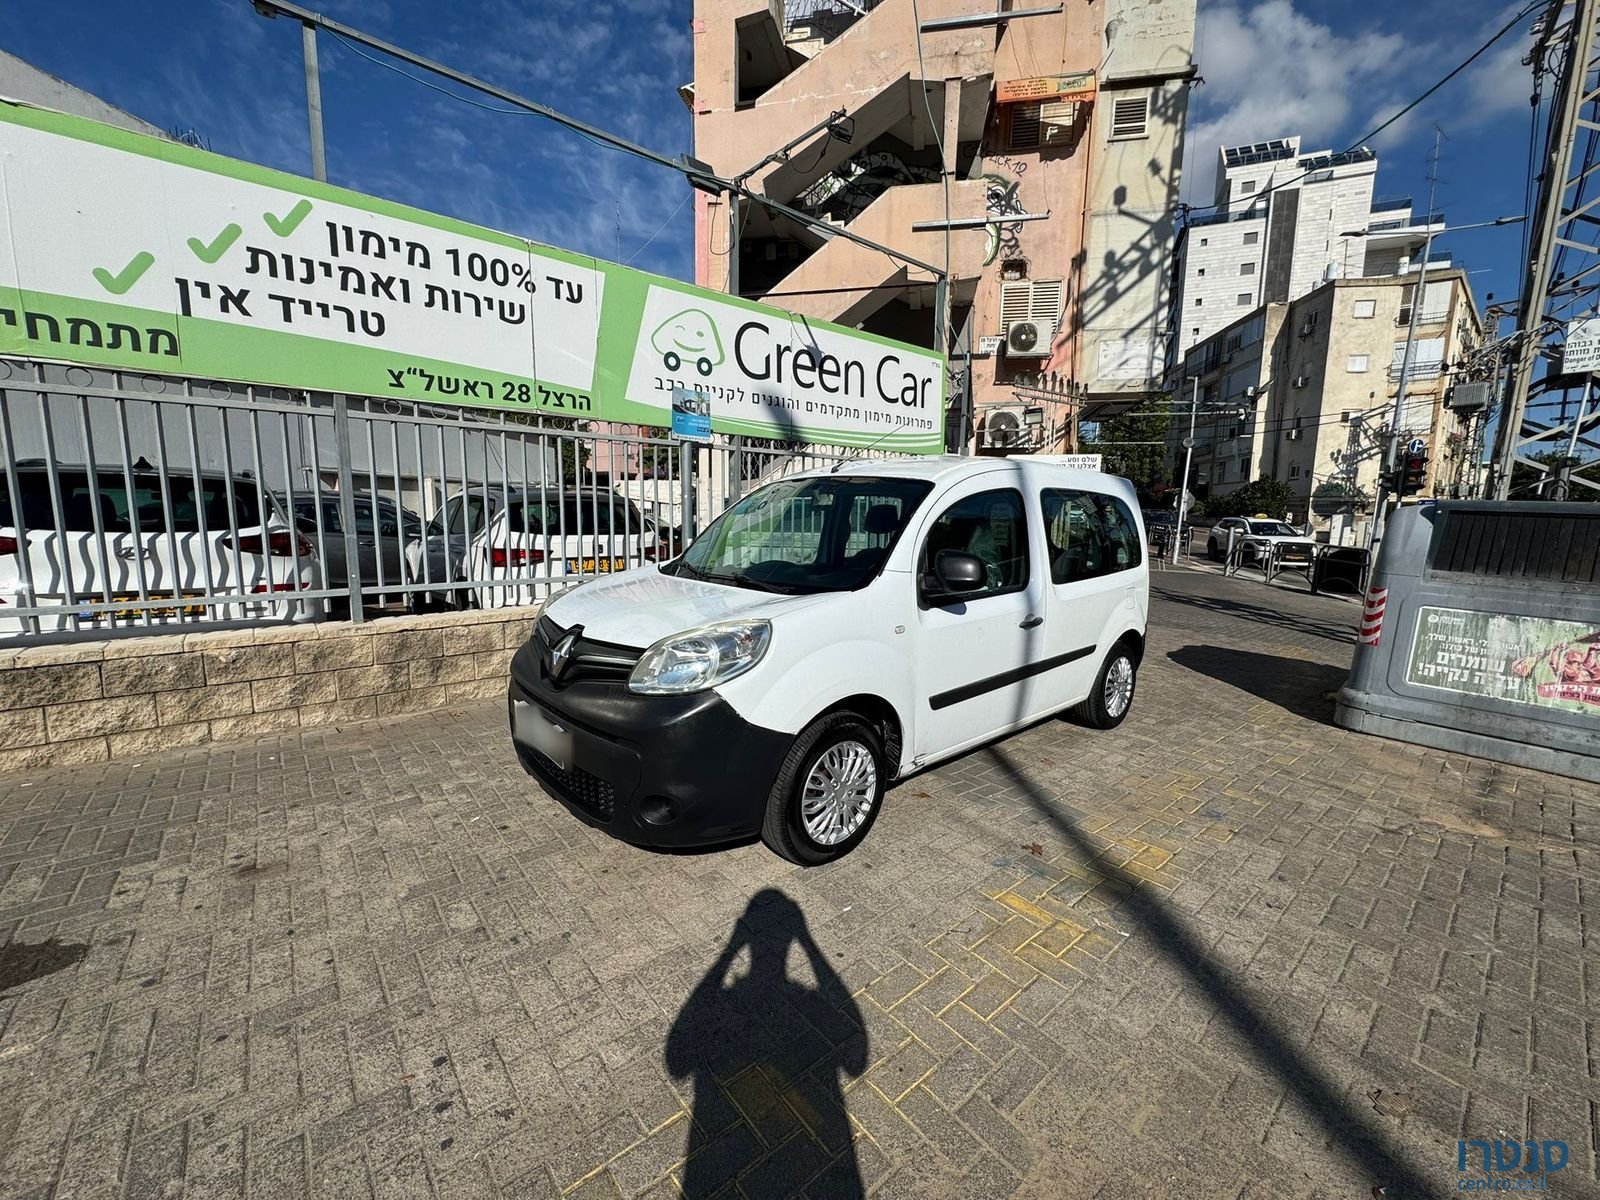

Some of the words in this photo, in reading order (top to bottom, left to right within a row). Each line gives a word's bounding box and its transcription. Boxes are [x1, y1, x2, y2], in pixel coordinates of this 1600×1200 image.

[326, 221, 431, 269] מימון
[245, 246, 411, 304] ואמינות
[446, 248, 537, 294] 100%
[175, 276, 253, 318] אין
[546, 275, 584, 304] עד
[268, 292, 386, 338] טרייד
[424, 285, 526, 326] שירות
[734, 321, 865, 398] Green
[876, 355, 932, 409] Car
[1565, 356, 1587, 365] Danger
[501, 380, 532, 404] 28
[538, 386, 592, 412] הרצל
[751, 392, 800, 411] והוגנים
[805, 401, 860, 420] מתקדמים
[864, 410, 892, 423] מימון
[895, 414, 933, 430] פתרונות
